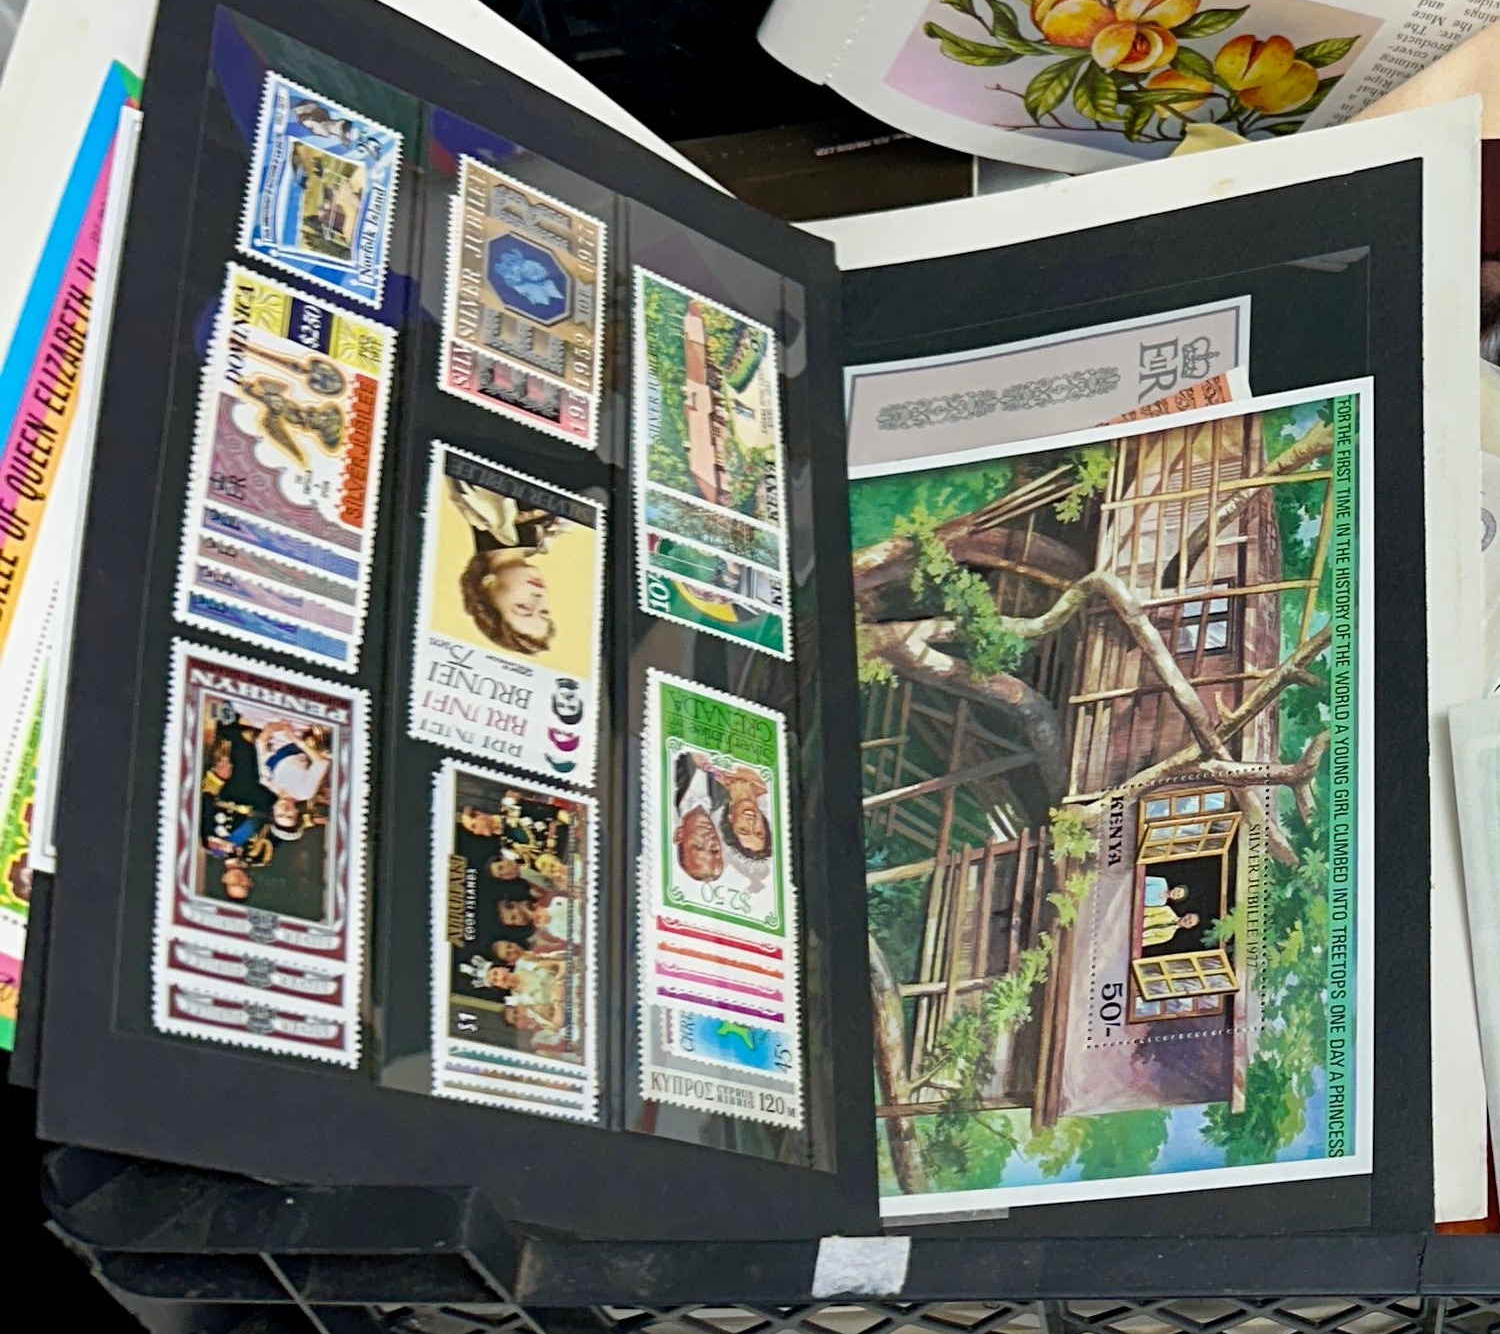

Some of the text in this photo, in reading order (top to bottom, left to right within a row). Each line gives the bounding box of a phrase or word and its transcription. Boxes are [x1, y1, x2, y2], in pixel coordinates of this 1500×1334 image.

[1397, 32, 1453, 53] products
[1403, 21, 1427, 36] The
[1411, 9, 1473, 32] the Mace
[1388, 44, 1428, 58] cover-
[360, 186, 387, 278] Norfolk Island
[458, 173, 489, 340] SILVER JUBILEE
[577, 224, 597, 273] 1977
[32, 284, 94, 416] ELIZABETH
[224, 284, 255, 384] DOMINICA
[4, 411, 58, 502] QUEEN
[344, 456, 369, 520] SILVER
[765, 459, 779, 522] KENYA
[0, 499, 29, 542] OF
[188, 668, 350, 724] PENRHYN
[427, 660, 533, 711] BRUNEI
[668, 689, 772, 744] GRENADA
[1328, 398, 1351, 1158] FOR THE FIRST TIME IN THE HISTORY OF THE WORLD A YOUNG GIRL CLIMBED INTO TREETOPS ONE DAY A PRINCESS
[1108, 796, 1125, 868] KENYA
[1245, 823, 1260, 968] SILVER JUBILEE 1977
[458, 1011, 478, 1034] $1
[1099, 982, 1124, 1037] 50/-
[651, 1070, 714, 1101] ΚΥΠΡΟΣ
[716, 1083, 754, 1099] CYPRUS
[716, 1094, 754, 1110] KIBRIS
[758, 1091, 785, 1116] 120
